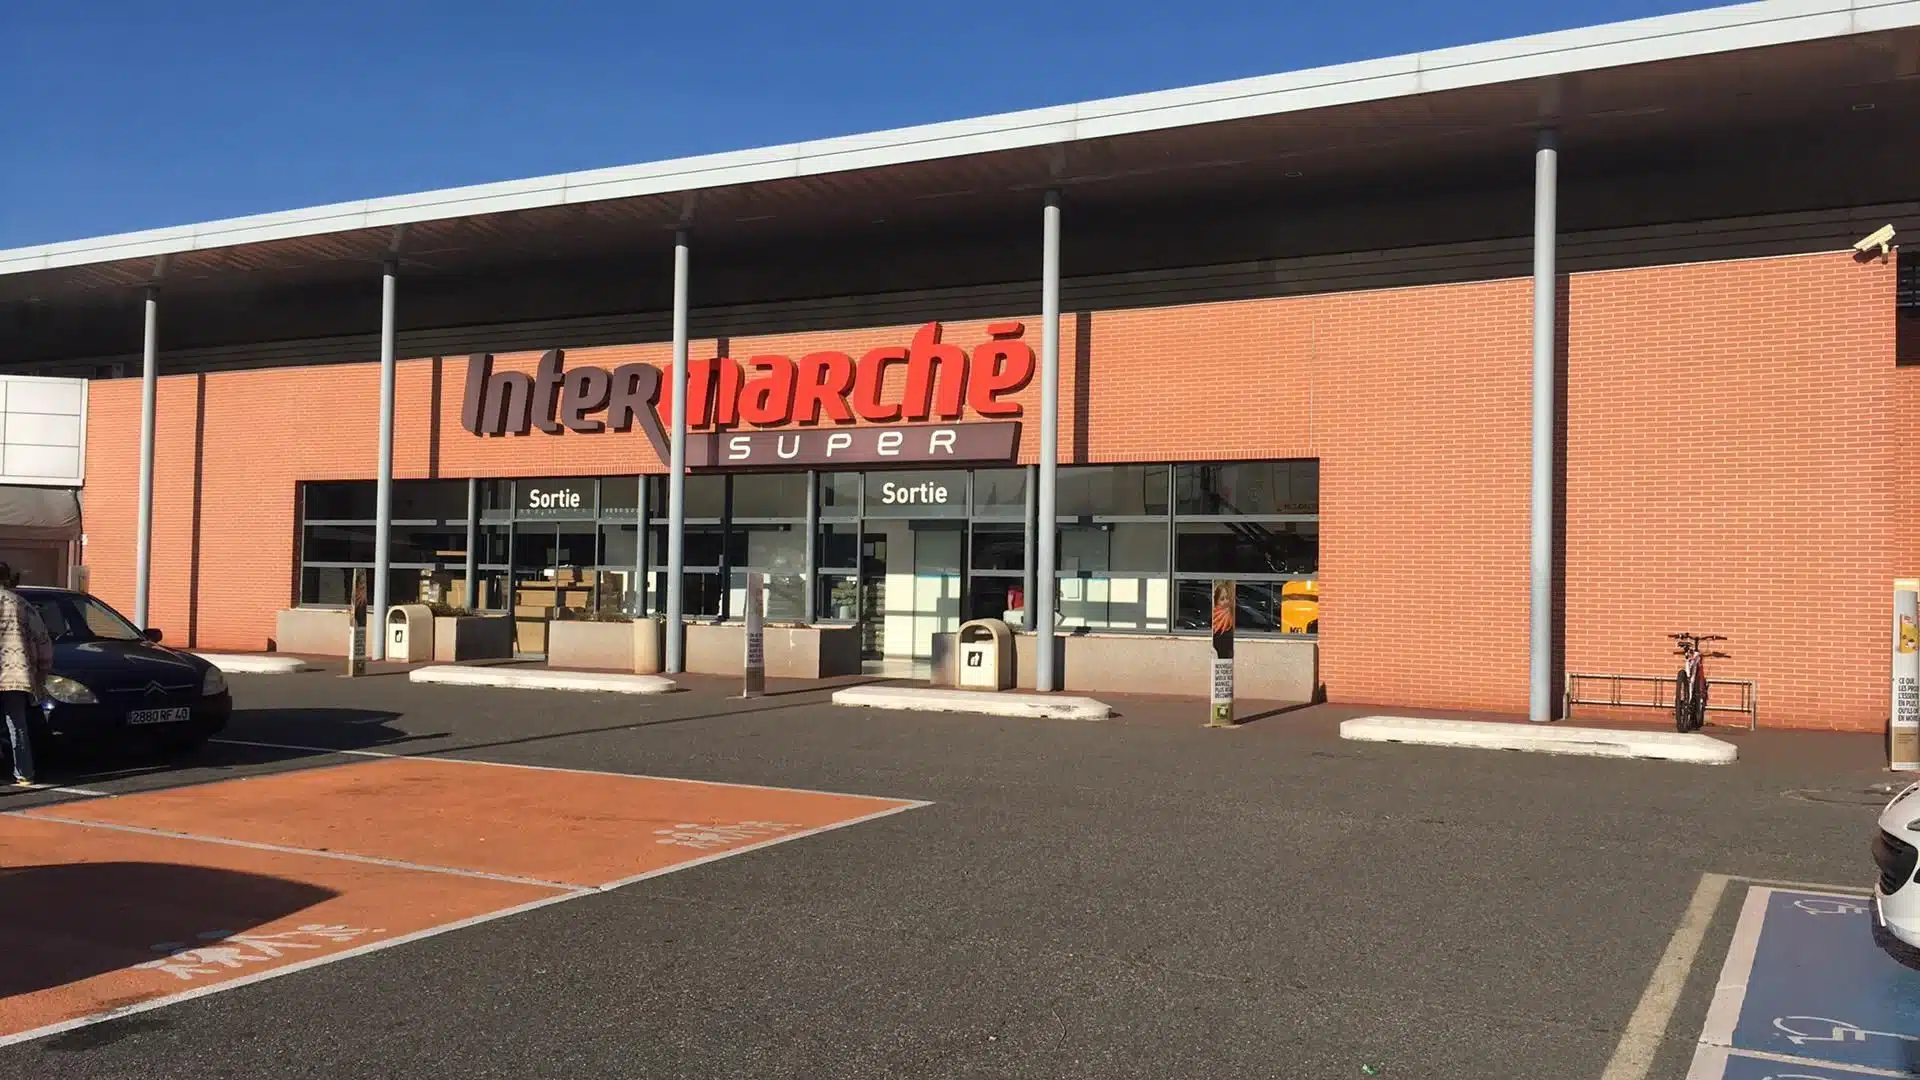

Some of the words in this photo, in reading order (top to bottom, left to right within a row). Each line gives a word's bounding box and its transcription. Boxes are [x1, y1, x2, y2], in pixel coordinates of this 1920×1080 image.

[727, 429, 957, 461] SUPER
[529, 488, 580, 508] Sortie
[881, 481, 948, 504] Sortie
